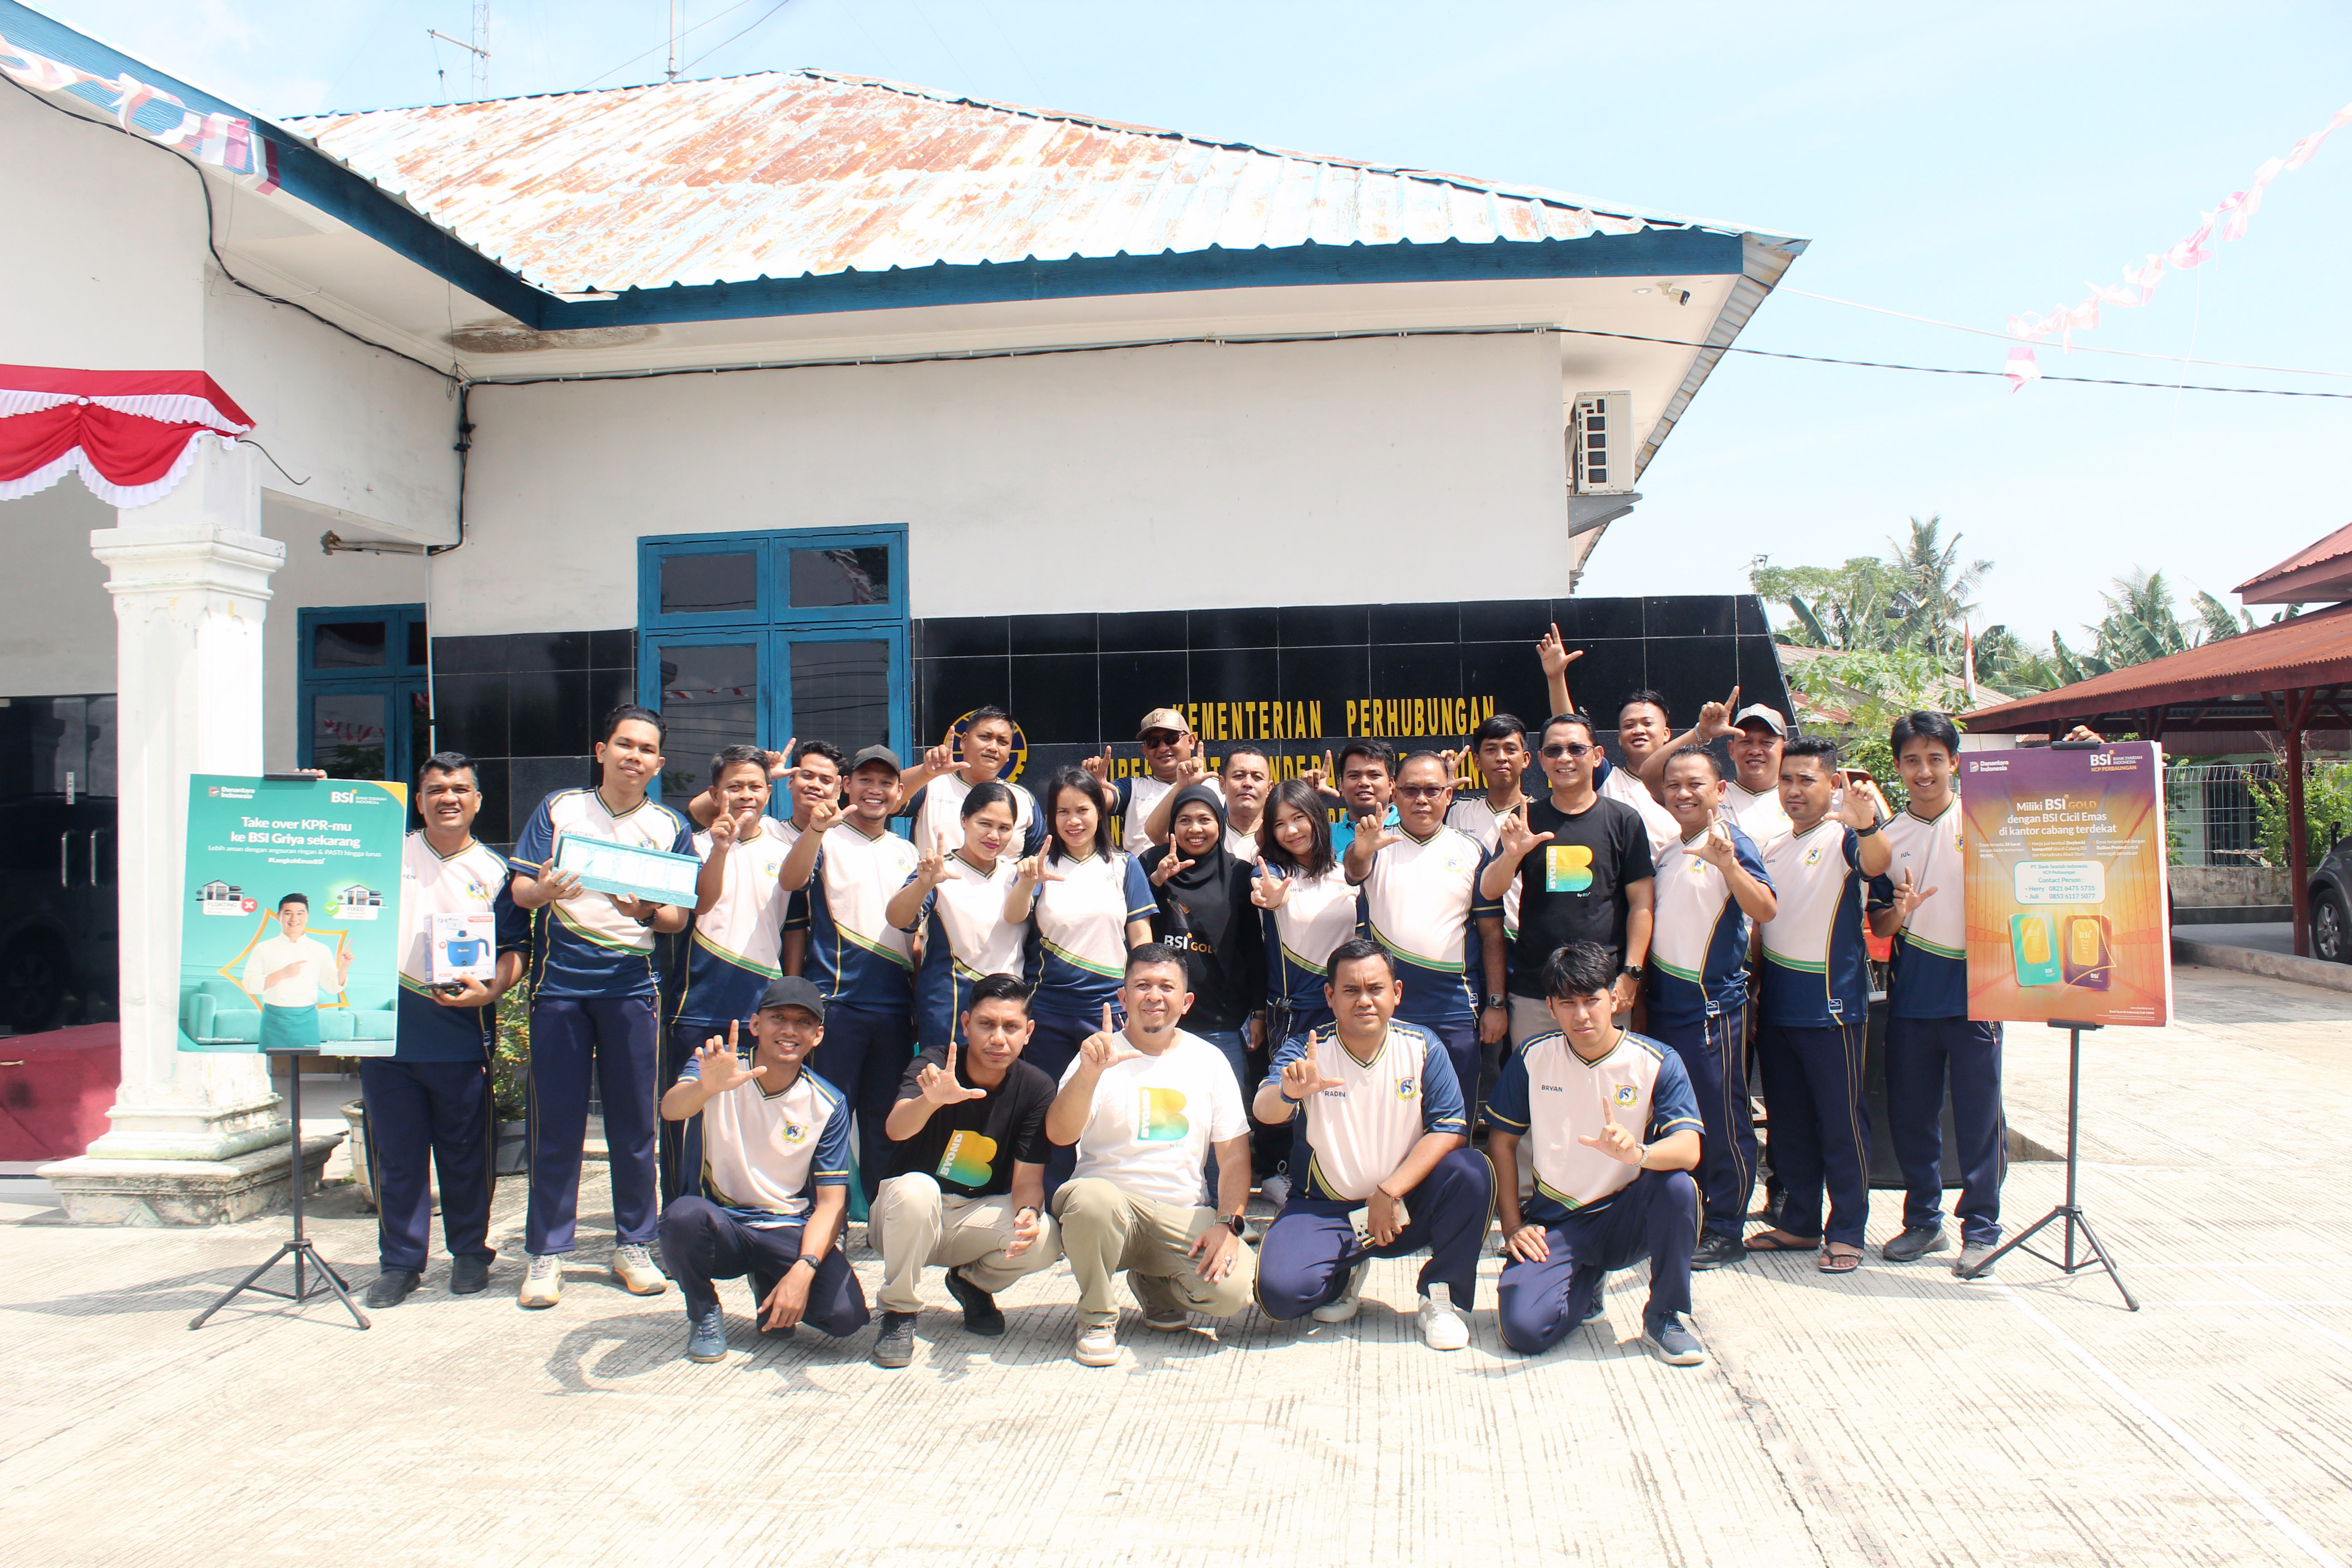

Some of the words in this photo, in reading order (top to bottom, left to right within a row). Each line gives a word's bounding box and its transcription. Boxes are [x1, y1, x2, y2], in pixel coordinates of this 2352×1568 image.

[2090, 753, 2111, 766] BSI
[330, 791, 354, 803] BSI
[2016, 801, 2043, 811] Miliki
[2045, 798, 2066, 810] BSI
[2068, 801, 2097, 809] GOLD
[241, 817, 270, 828] Take
[271, 821, 299, 829] over
[301, 819, 352, 831] KPR-mu
[2007, 815, 2041, 824] dengan
[2043, 813, 2058, 823] BSI
[2059, 812, 2080, 822] Cicil
[2082, 812, 2107, 822] Emas
[1999, 827, 2007, 836] di
[2009, 826, 2040, 835] kantor
[2041, 825, 2074, 836] cabang
[2076, 824, 2117, 834] terdekat
[230, 831, 246, 842] ke
[248, 832, 270, 843] BSI
[271, 833, 304, 846] Griya
[307, 835, 361, 849] sekarang
[1548, 848, 1557, 889] BYOND
[1164, 935, 1188, 950] BSI
[1191, 941, 1212, 953] GOL
[1141, 1089, 1151, 1138] BYOND
[940, 1133, 963, 1176] BYOND
